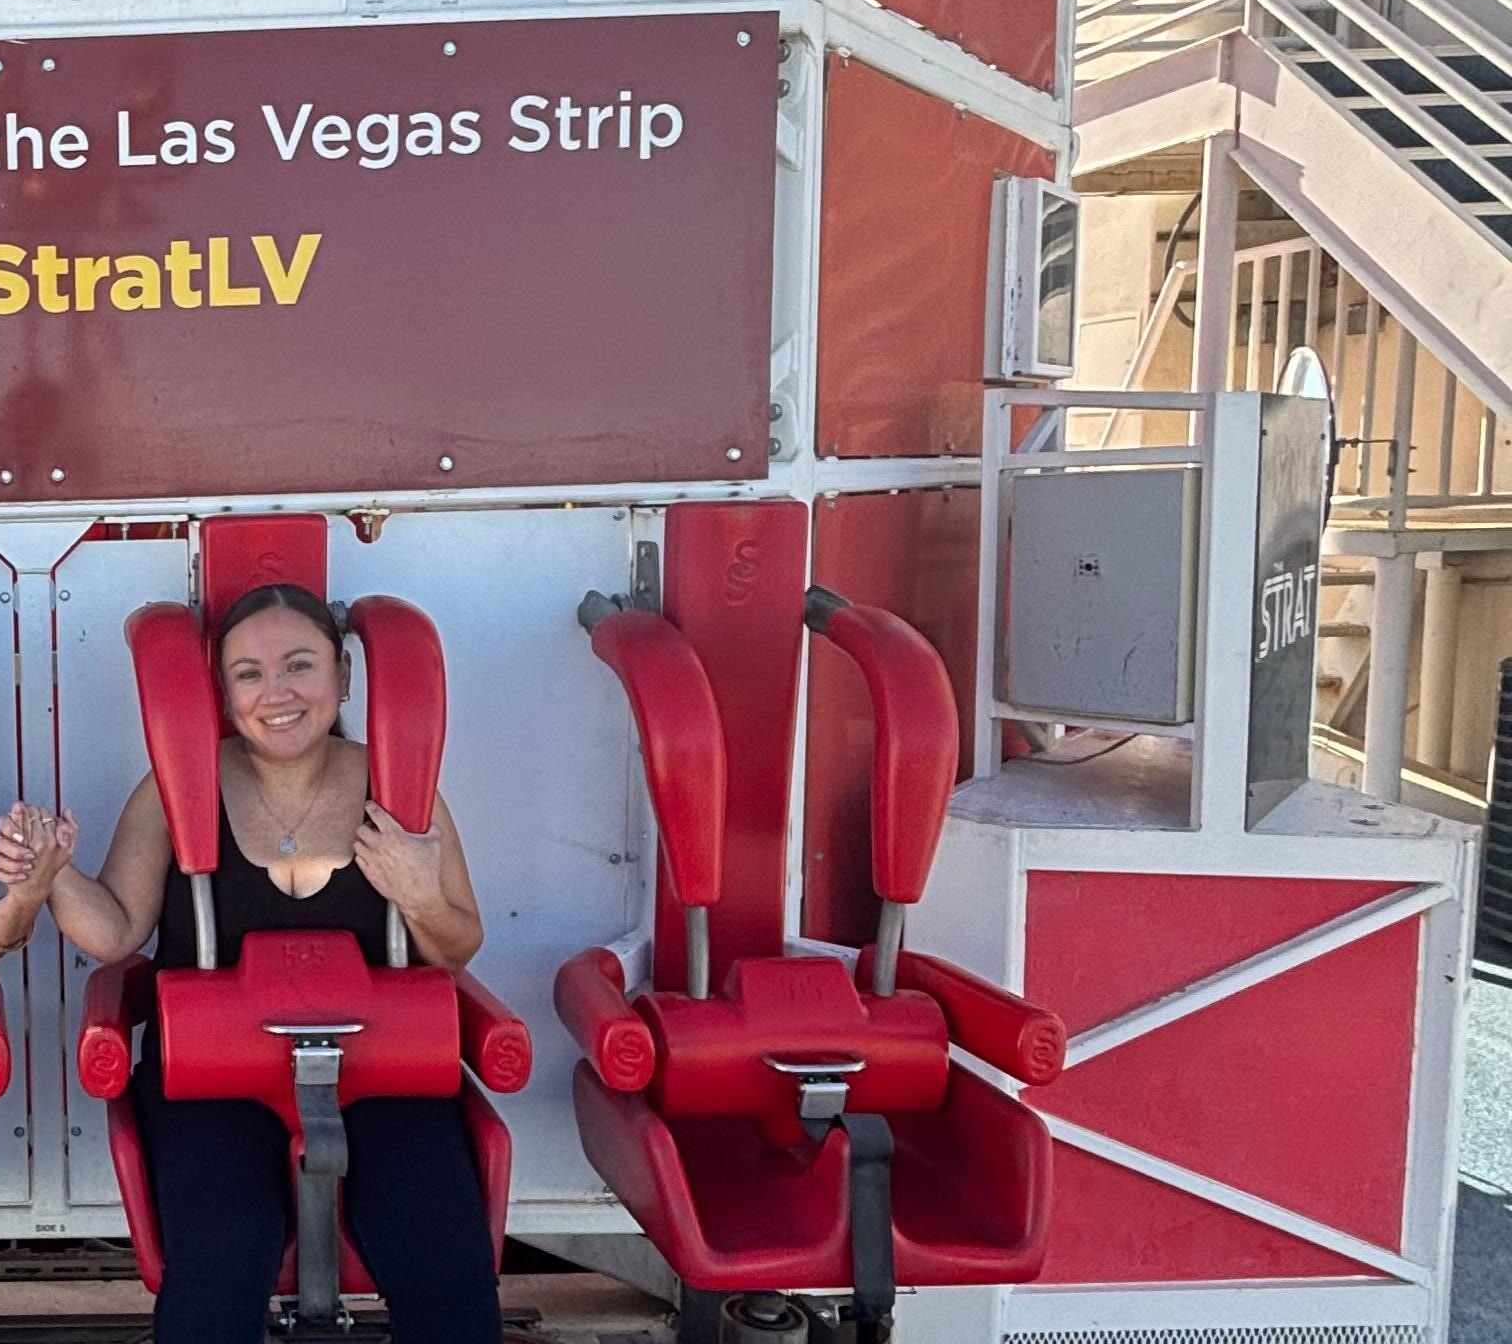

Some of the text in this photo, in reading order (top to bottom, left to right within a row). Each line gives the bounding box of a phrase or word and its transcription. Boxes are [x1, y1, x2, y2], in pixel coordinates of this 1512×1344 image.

[117, 110, 236, 167] Las
[260, 103, 482, 170] Vegas
[507, 90, 684, 160] Strip
[1258, 563, 1316, 659] STRAT
